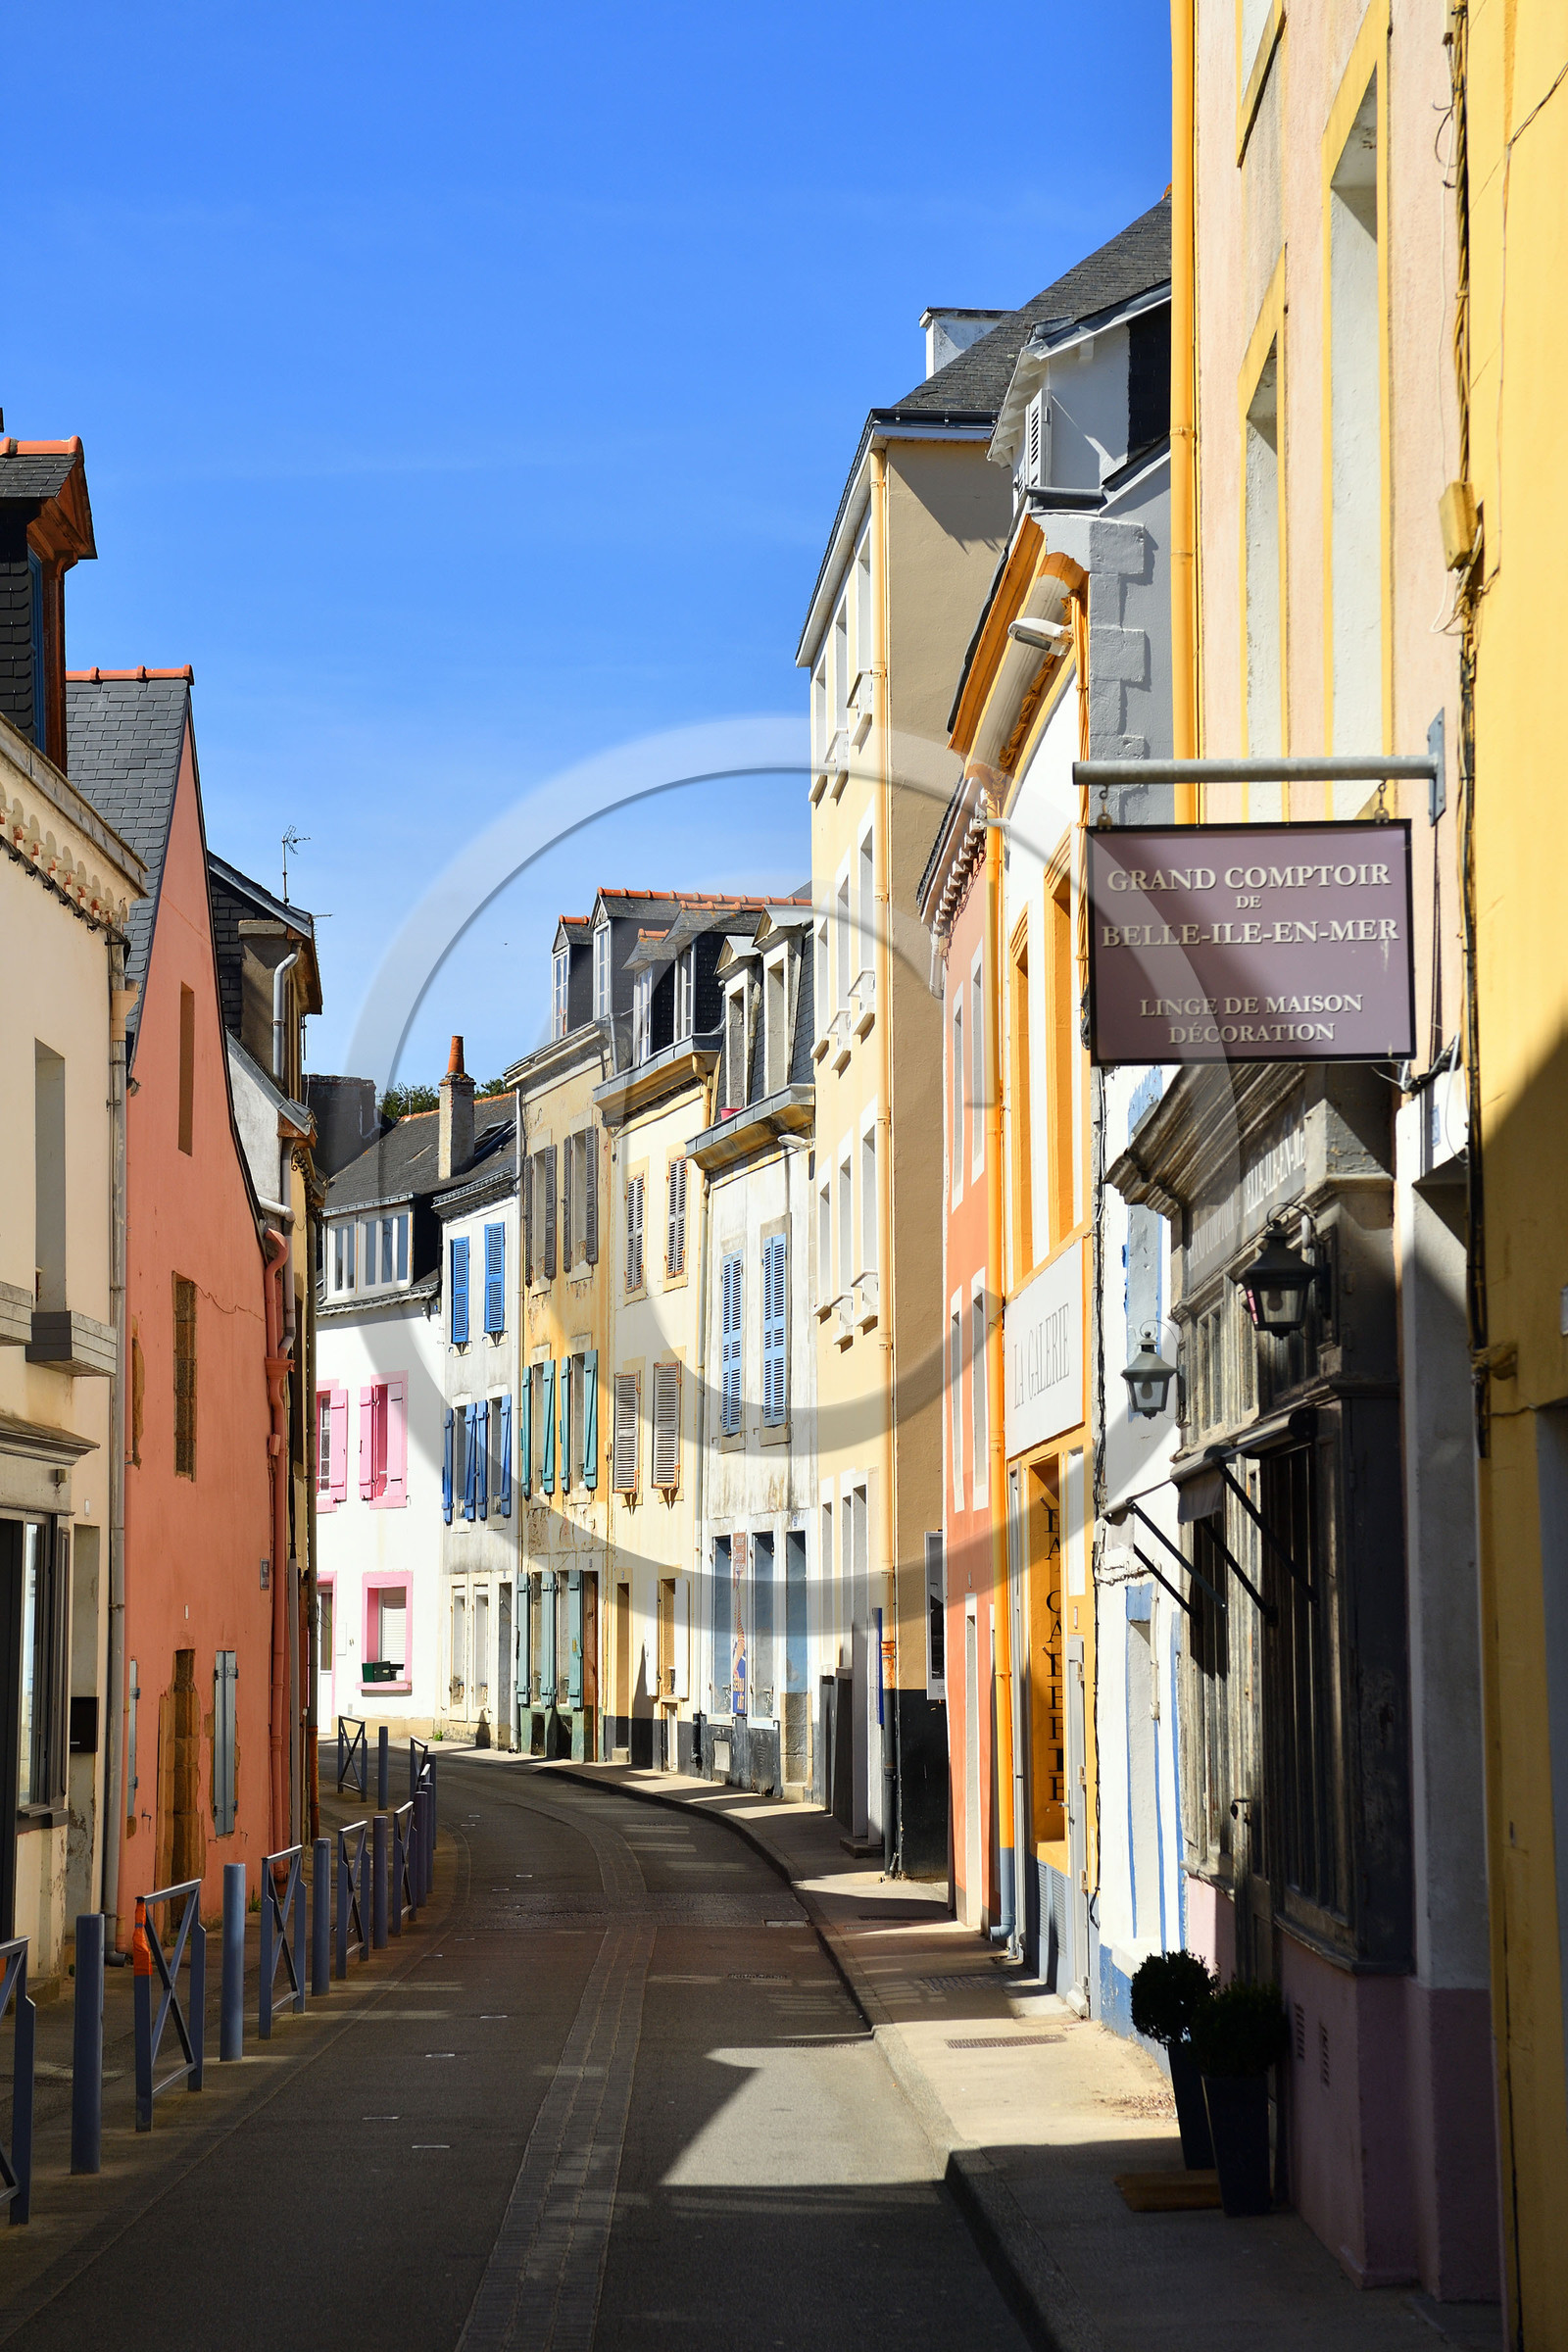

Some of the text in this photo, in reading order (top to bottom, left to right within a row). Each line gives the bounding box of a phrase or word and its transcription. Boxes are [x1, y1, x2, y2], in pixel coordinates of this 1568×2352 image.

[1107, 863, 1392, 892] GRAND COMPTOIR
[1235, 896, 1262, 909] DE
[1102, 918, 1399, 948] BELLE-ILE-EN-MER
[1139, 994, 1363, 1017] LINGE DE MAISON
[1168, 1022, 1336, 1045] DÉCORATION
[1014, 1302, 1070, 1409] LA GALERIE
